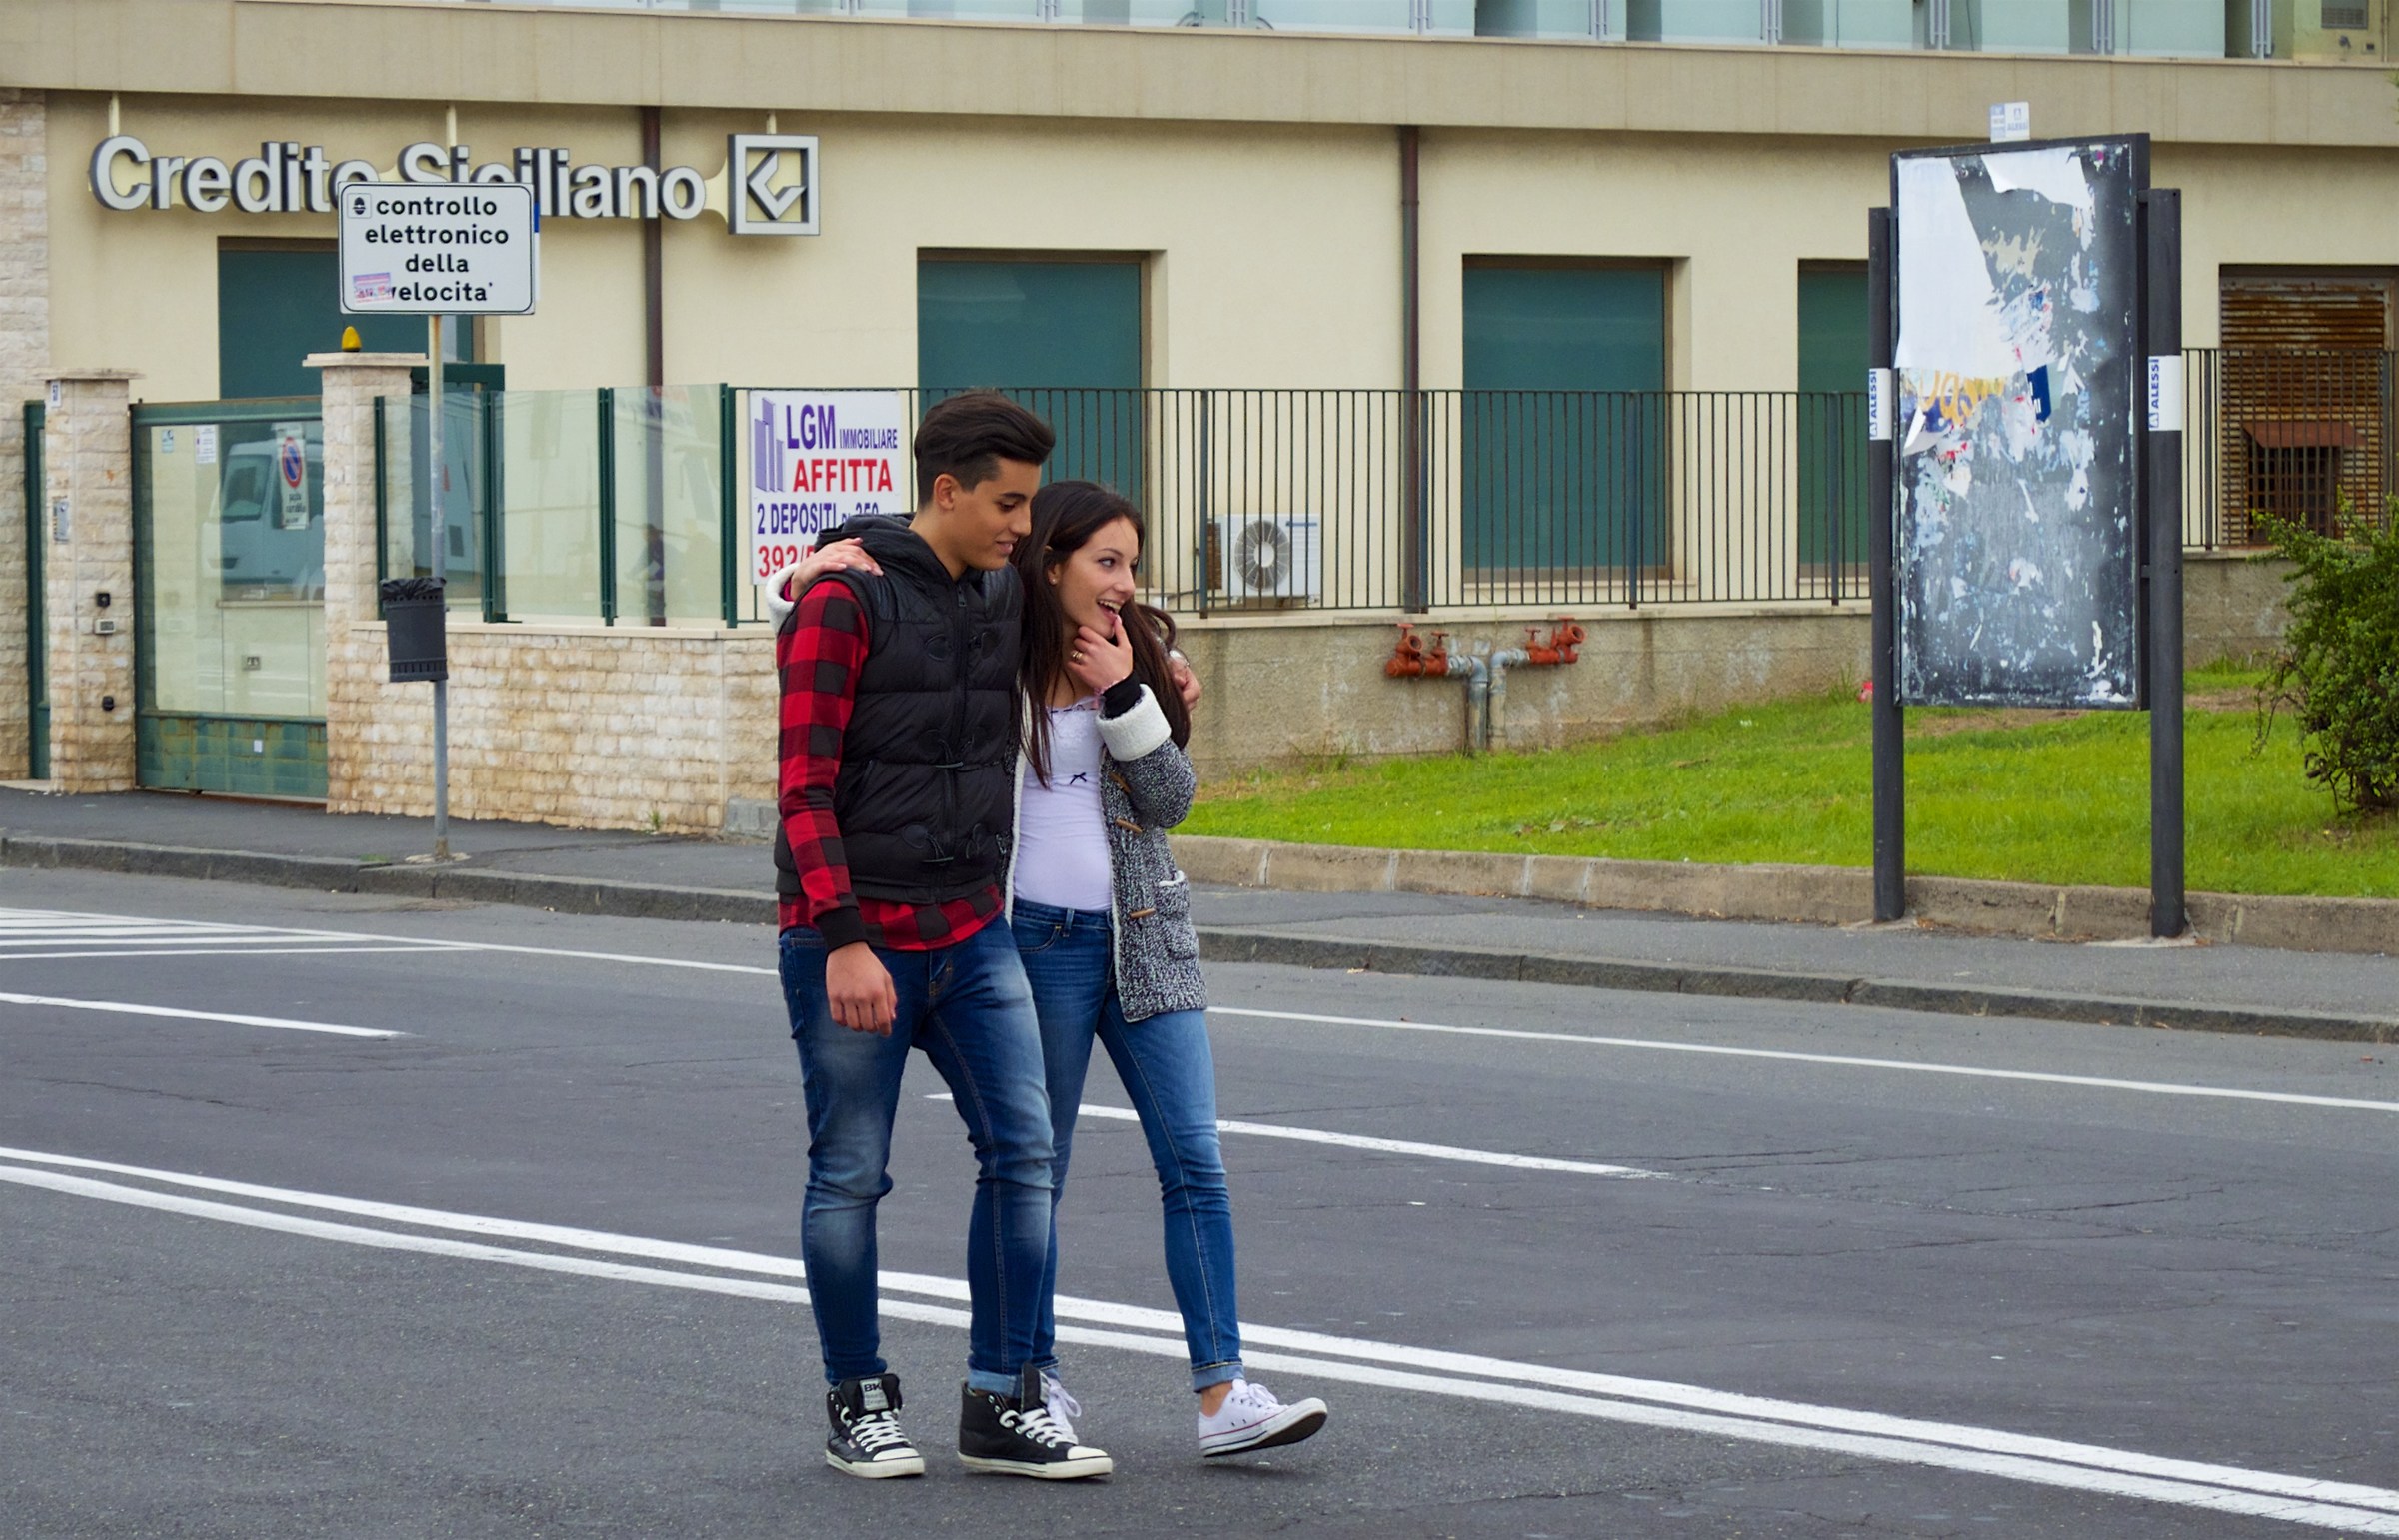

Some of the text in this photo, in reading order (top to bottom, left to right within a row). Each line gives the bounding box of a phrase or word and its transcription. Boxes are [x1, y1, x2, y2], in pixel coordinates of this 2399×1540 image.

[377, 196, 497, 215] controllo
[365, 224, 509, 244] elettronico
[405, 253, 469, 273] della
[2150, 359, 2159, 409] ALESSI
[786, 404, 898, 450] LGM IMMOBILIARE
[793, 458, 893, 493] AFFITTA
[757, 502, 766, 534] 2
[771, 503, 837, 534] DEPOSITI
